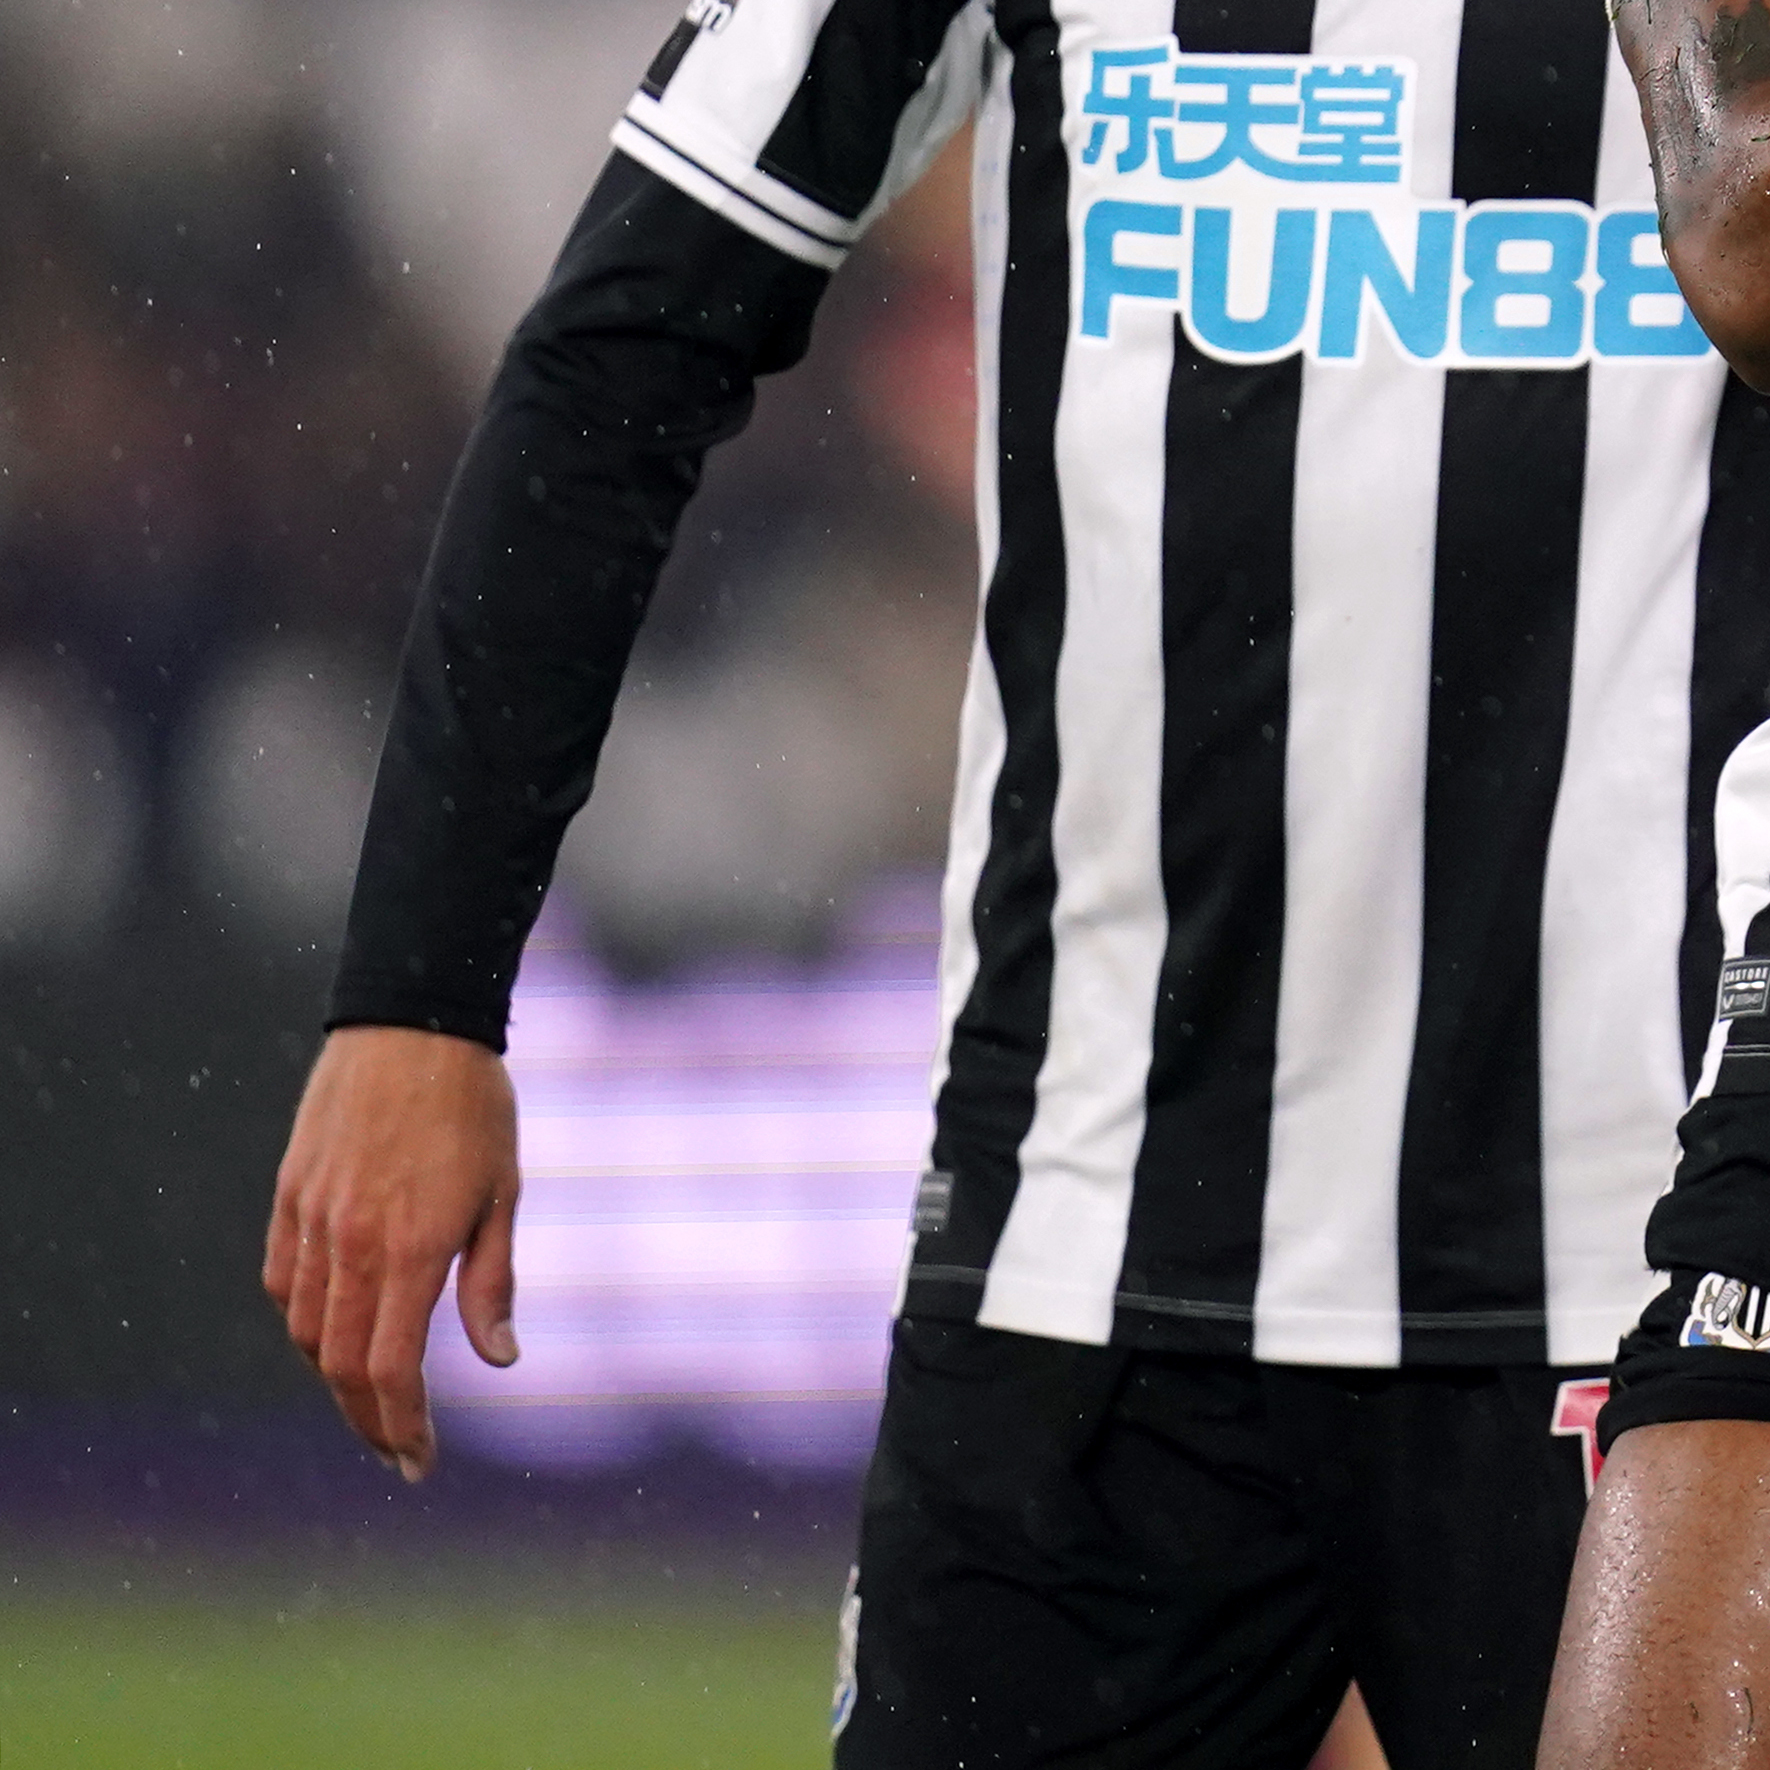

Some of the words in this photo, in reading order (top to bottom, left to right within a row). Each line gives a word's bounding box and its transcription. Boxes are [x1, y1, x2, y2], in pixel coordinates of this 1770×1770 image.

[1082, 44, 1406, 184] 乐天堂
[1080, 199, 1712, 360] FUN88
